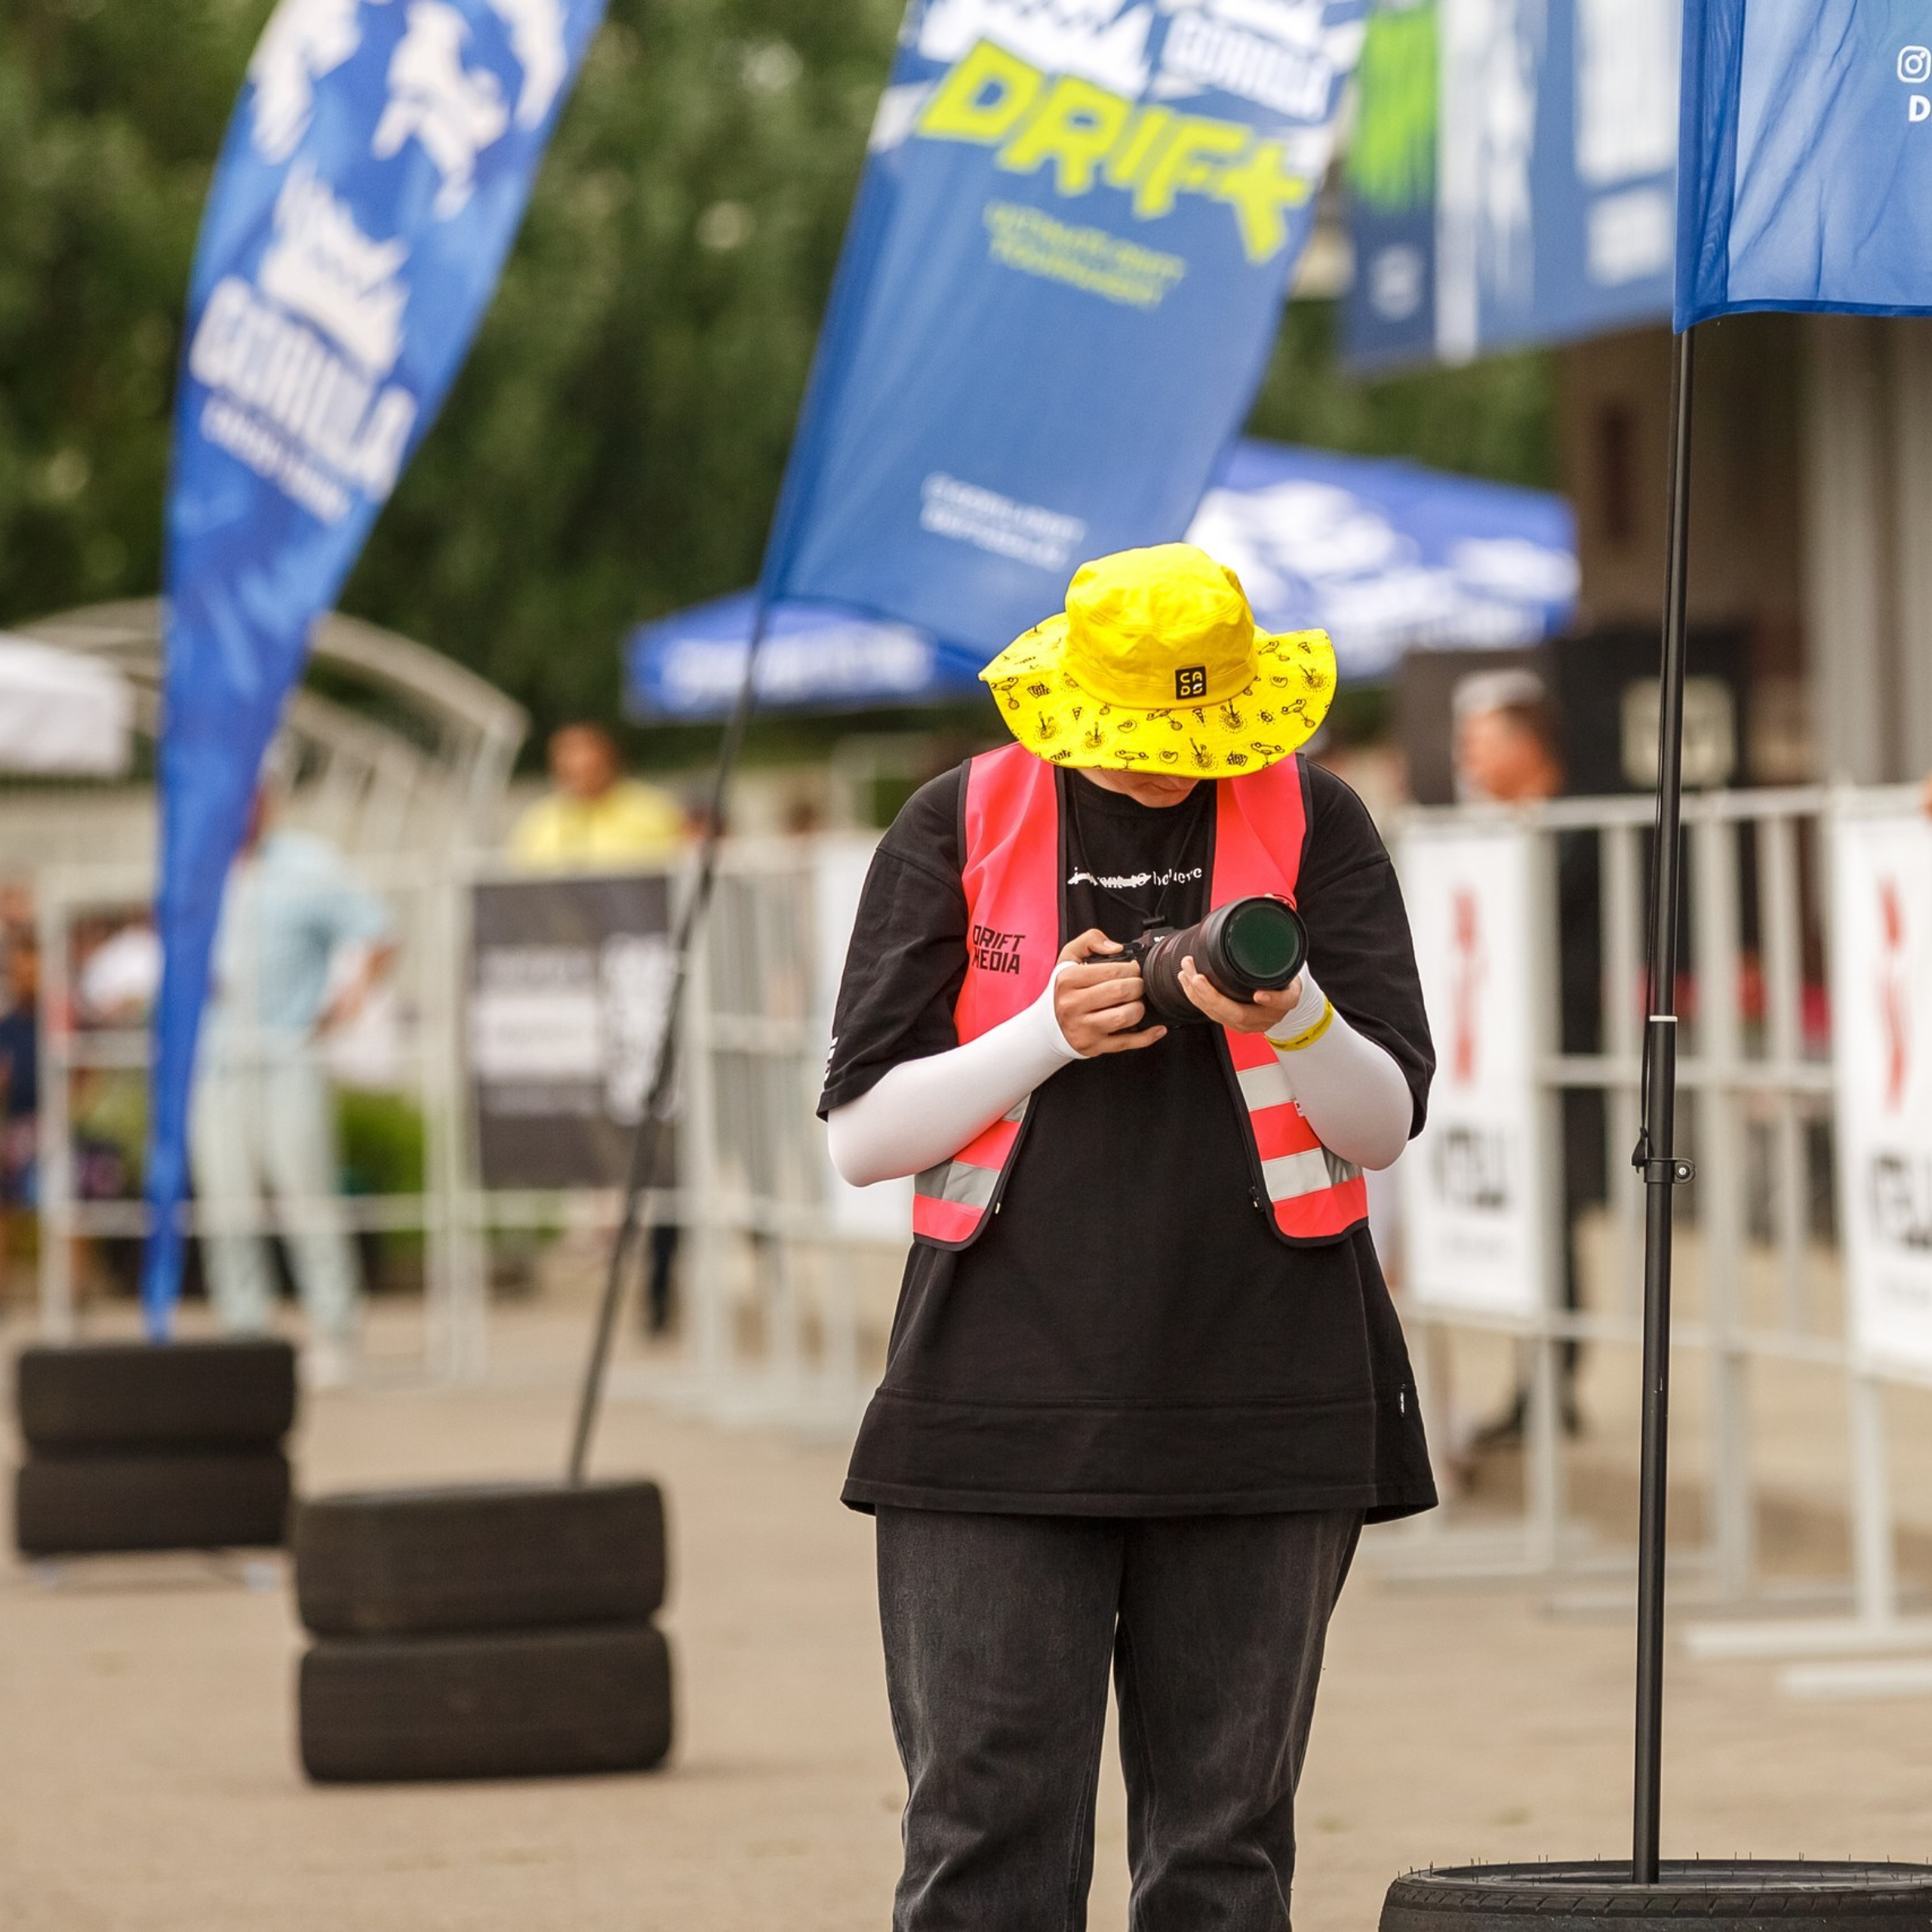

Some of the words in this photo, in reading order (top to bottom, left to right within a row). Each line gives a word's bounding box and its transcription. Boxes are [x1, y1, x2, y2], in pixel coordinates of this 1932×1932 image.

[1909, 94, 1932, 122] D
[973, 924, 1026, 952] DRIFT
[972, 947, 1020, 974] MEDIA
